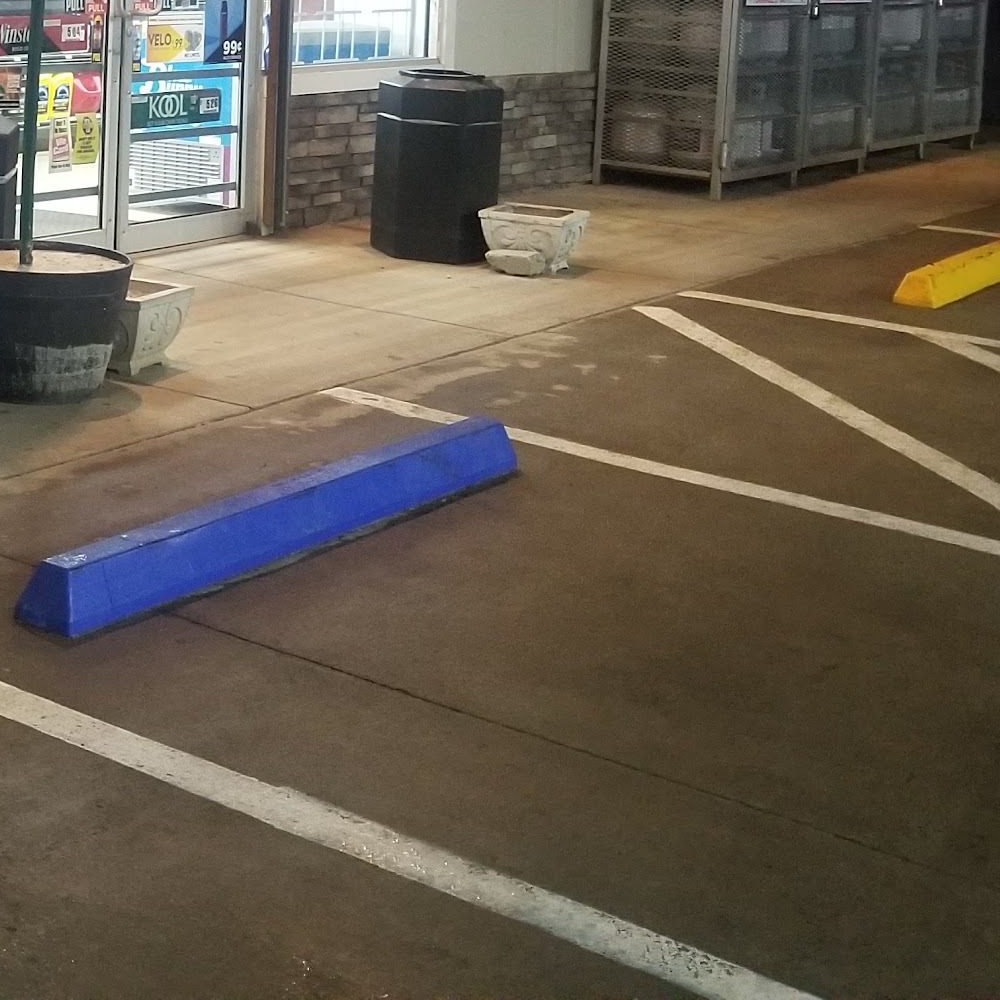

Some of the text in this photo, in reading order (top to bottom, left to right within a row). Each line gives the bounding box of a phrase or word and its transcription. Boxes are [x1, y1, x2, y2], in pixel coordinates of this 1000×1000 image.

[88, 3, 105, 12] PULL
[134, 3, 151, 11] PULL
[148, 33, 172, 47] VELO
[223, 40, 243, 56] 99¢
[148, 93, 188, 119] KOOL
